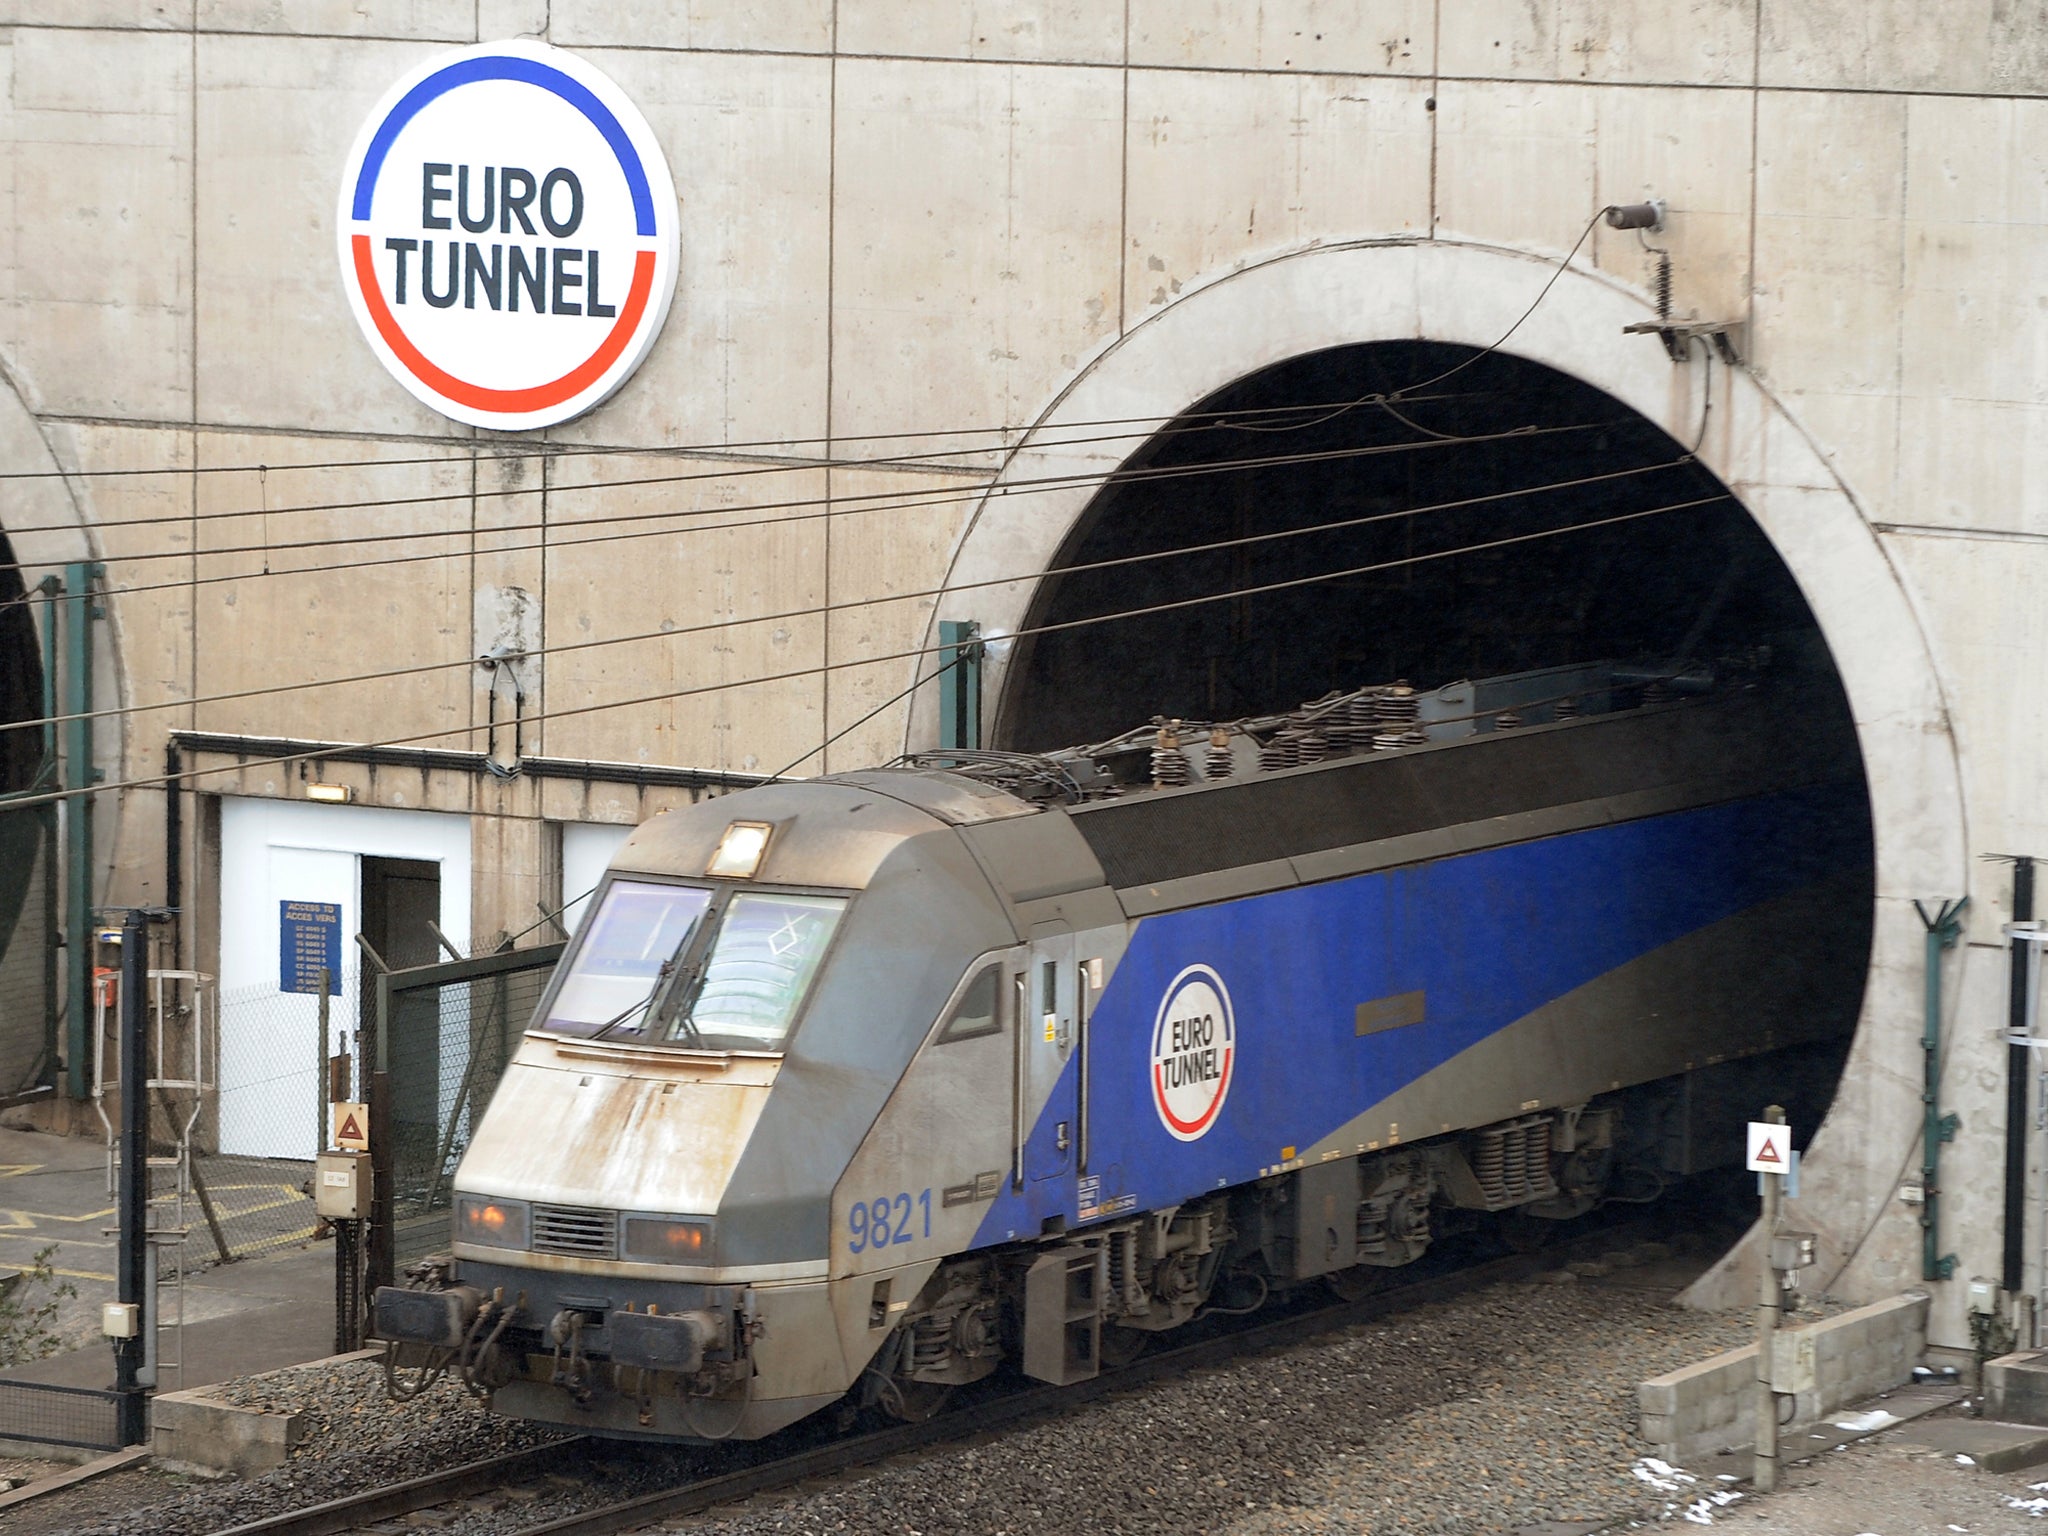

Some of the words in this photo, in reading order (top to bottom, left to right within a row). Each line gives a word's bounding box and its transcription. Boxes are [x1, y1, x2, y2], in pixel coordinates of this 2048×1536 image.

[423, 162, 584, 238] EURO
[385, 237, 616, 318] TUNNEL
[288, 903, 320, 912] ACCESS
[324, 904, 334, 913] TO
[316, 913, 337, 923] VERS
[1172, 1013, 1213, 1053] EURO
[1163, 1048, 1221, 1090] TUNNEL
[849, 1187, 931, 1255] 9821
